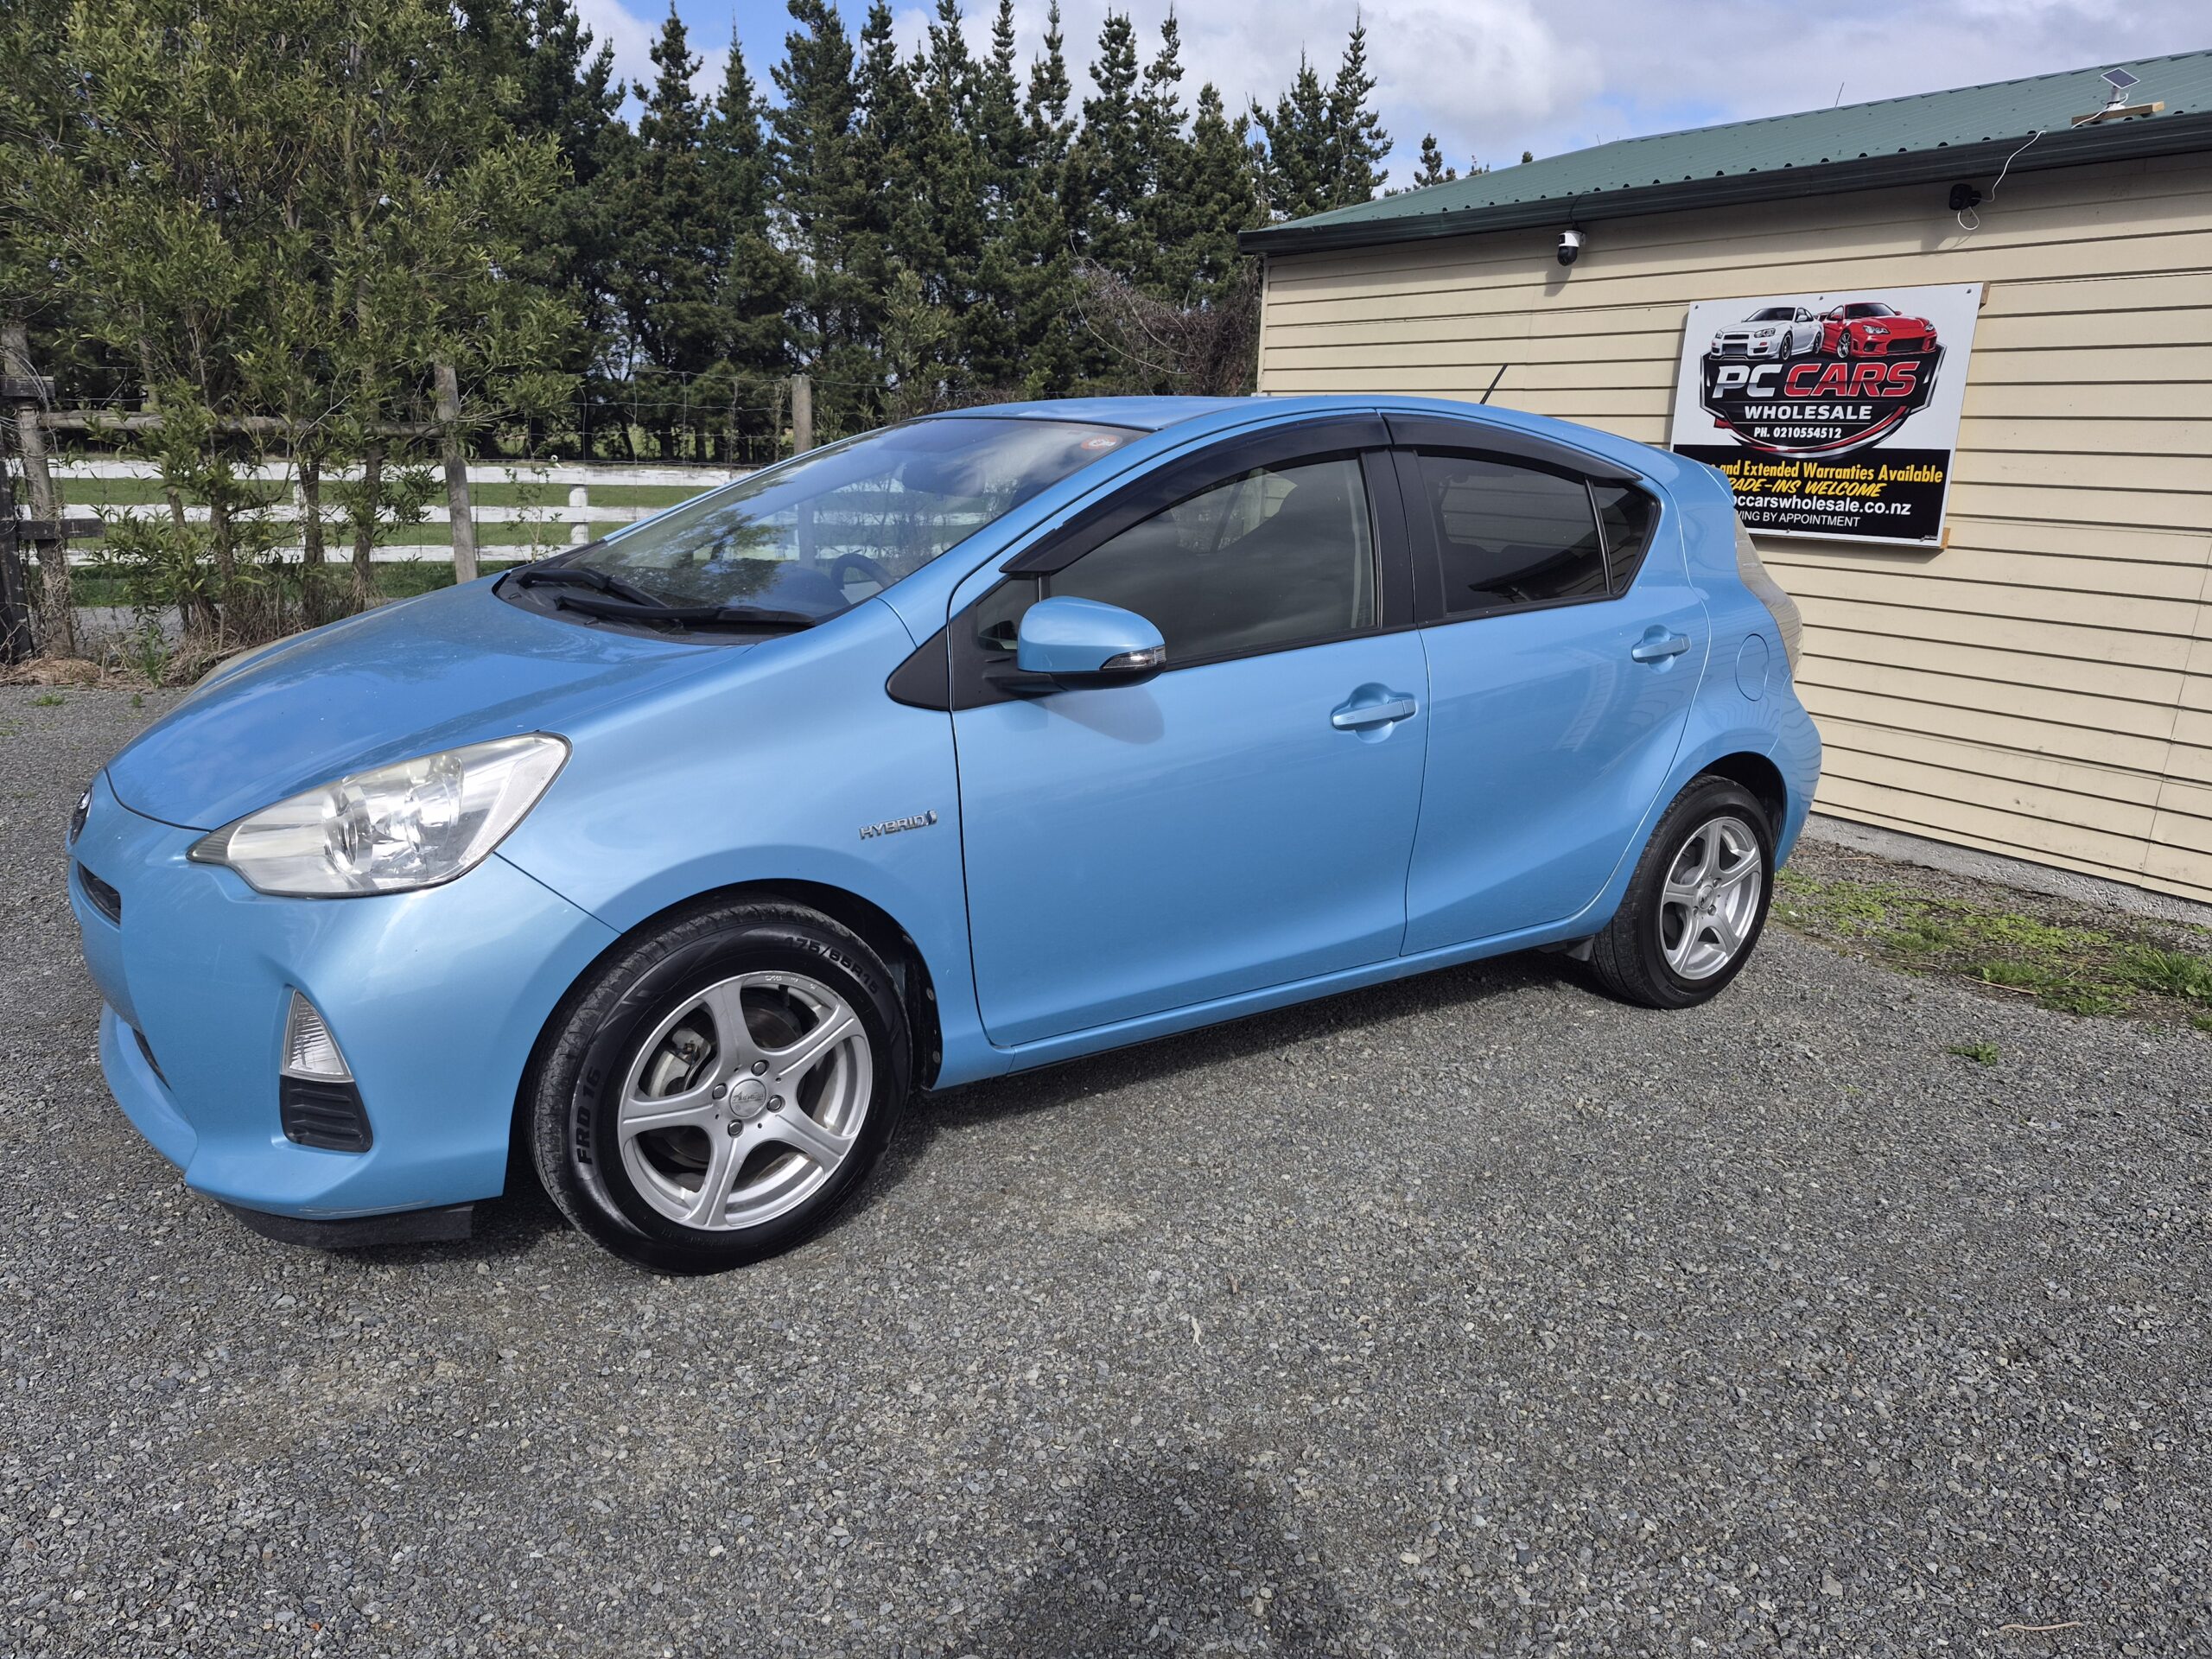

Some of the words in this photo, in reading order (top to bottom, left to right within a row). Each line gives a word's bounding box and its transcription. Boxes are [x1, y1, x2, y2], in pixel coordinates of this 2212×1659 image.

[1712, 364, 1783, 398] PC
[1783, 361, 1921, 397] CARS
[1744, 405, 1873, 420] WHOLESALE
[1753, 427, 1770, 438] PH.
[1773, 427, 1842, 439] 0210554512
[1719, 459, 1742, 475] and
[1743, 460, 1800, 478] Extended
[1803, 461, 1875, 480] Warranties
[1878, 464, 1943, 483] Available
[1728, 477, 1802, 493] RADE-INS
[1804, 480, 1888, 498] WELCOME
[1763, 512, 1778, 523] BY
[1778, 513, 1861, 527] APPOINTMENT
[859, 814, 925, 840] HYBRID
